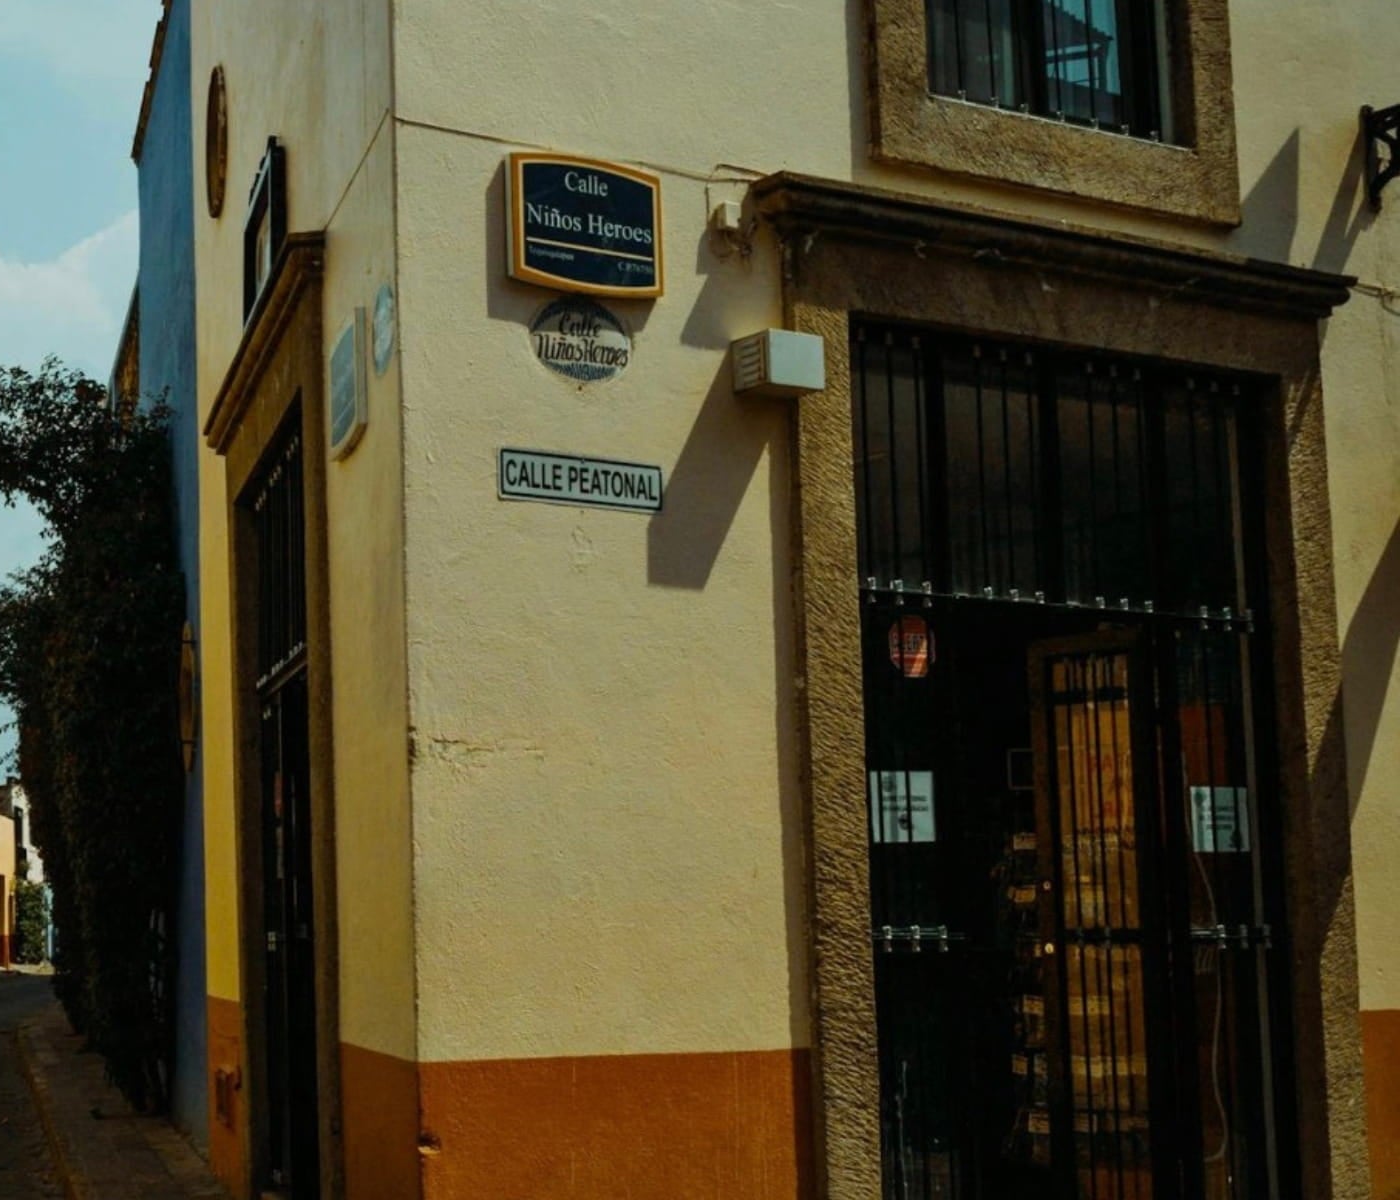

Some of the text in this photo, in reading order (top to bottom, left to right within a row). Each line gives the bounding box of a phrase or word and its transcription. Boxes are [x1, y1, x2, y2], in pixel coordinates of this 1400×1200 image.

[564, 171, 609, 197] Calle
[527, 202, 652, 244] Niños Heroes
[558, 311, 601, 338] Calle
[534, 333, 582, 361] Niños
[505, 459, 658, 501] CALLE PEATONAL
